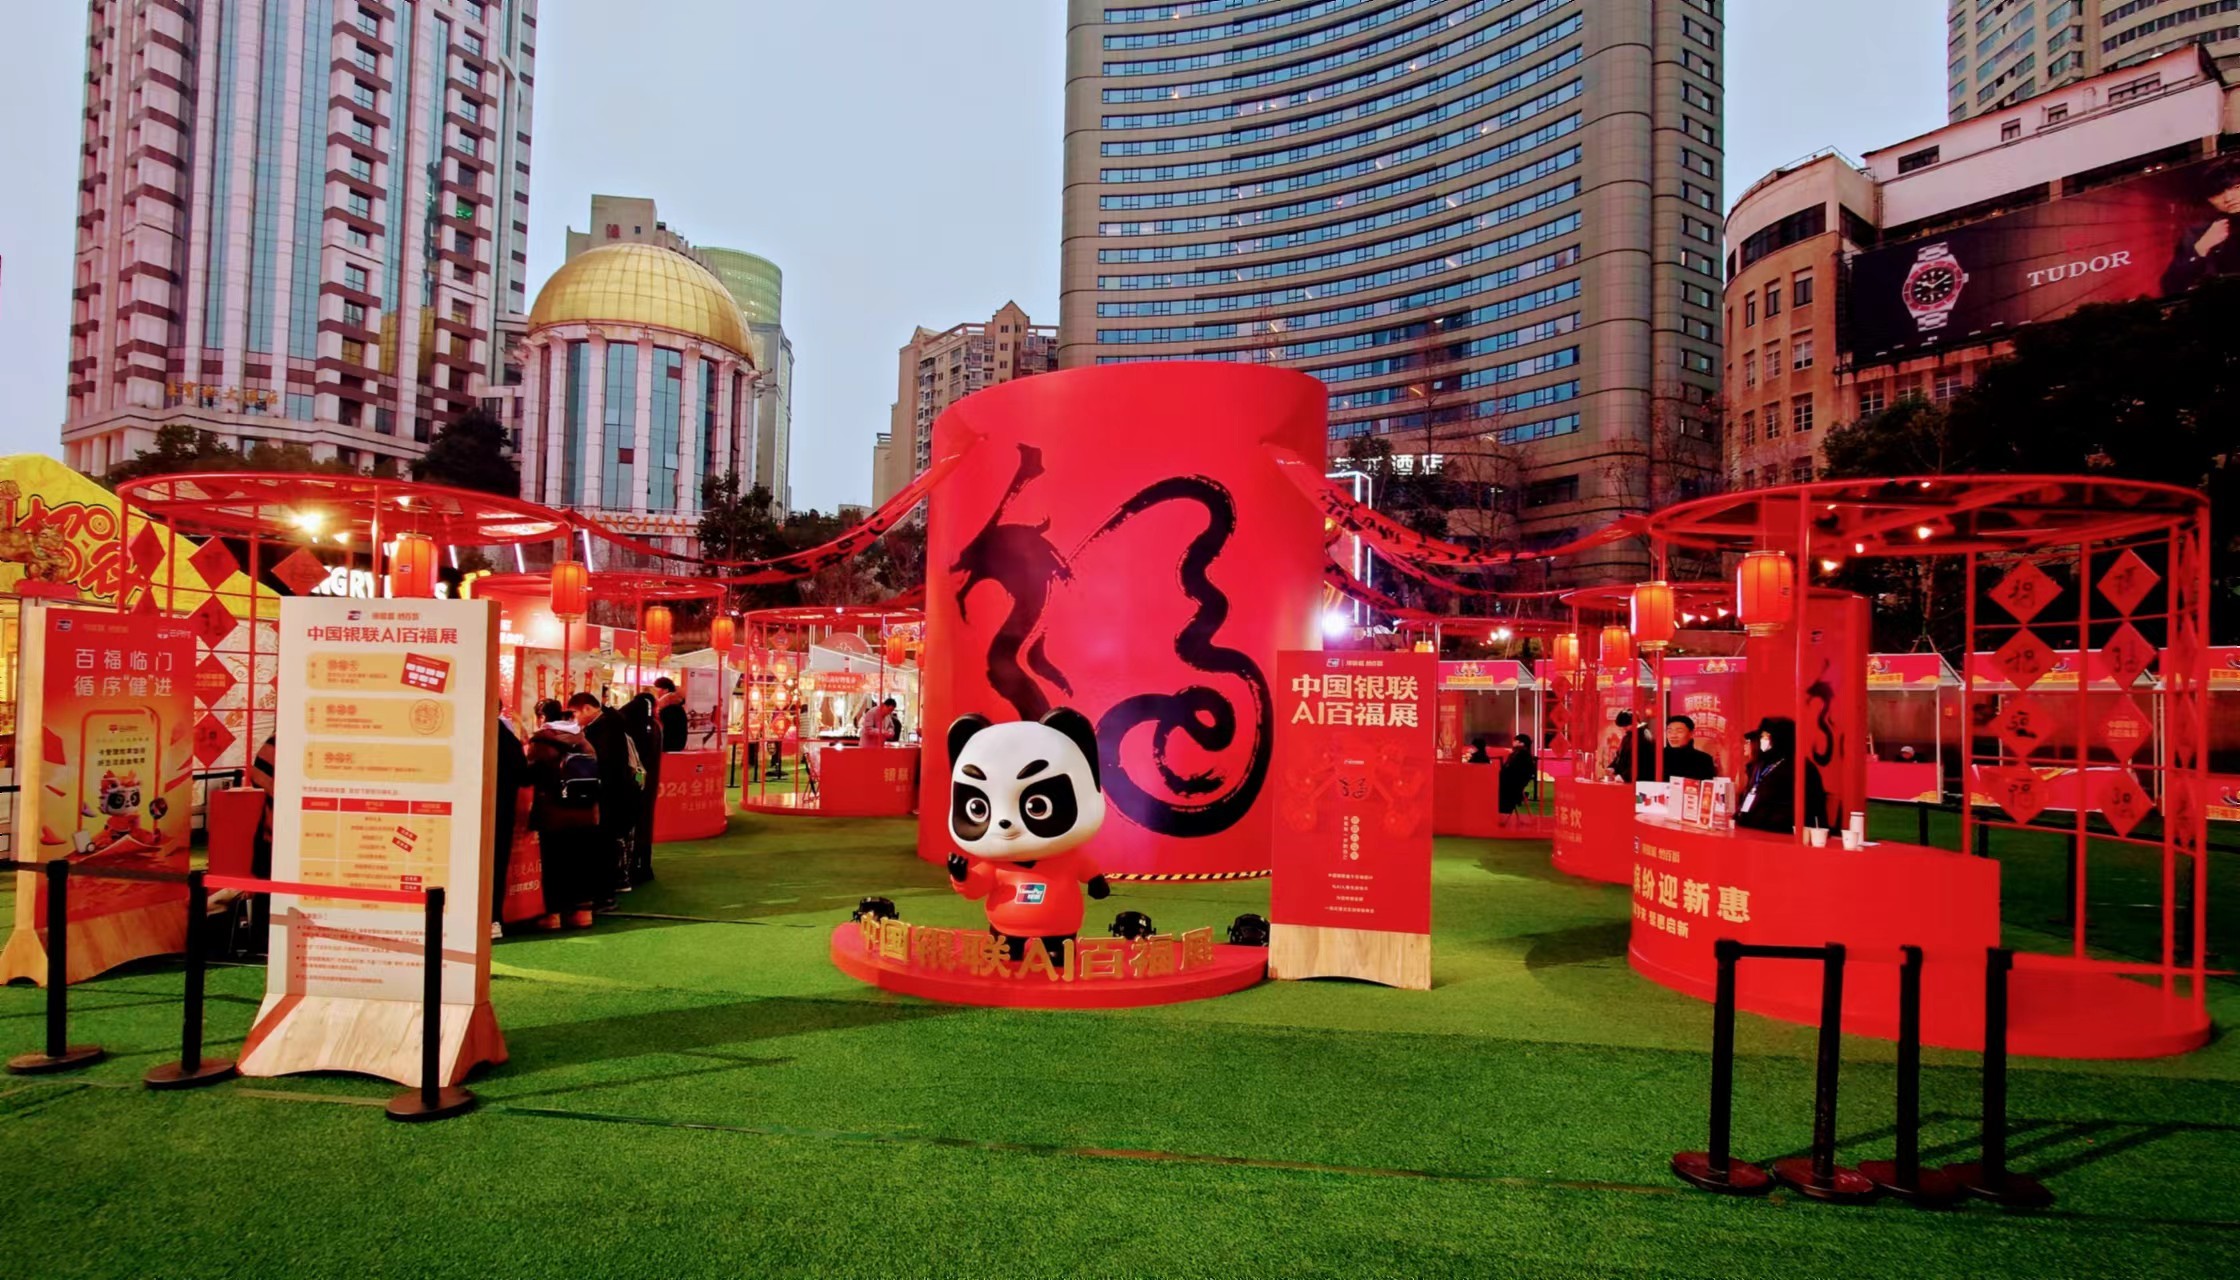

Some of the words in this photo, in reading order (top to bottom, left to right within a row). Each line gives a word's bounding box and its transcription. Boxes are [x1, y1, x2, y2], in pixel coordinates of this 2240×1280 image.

[2027, 251, 2131, 286] TUDOR
[307, 625, 458, 644] 中国银联AI百福展
[75, 648, 173, 672] 百福临门
[1291, 674, 1419, 700] 中国银联
[1291, 701, 1419, 728] AI百福展
[858, 910, 1215, 982] 中国银联AI百福展
